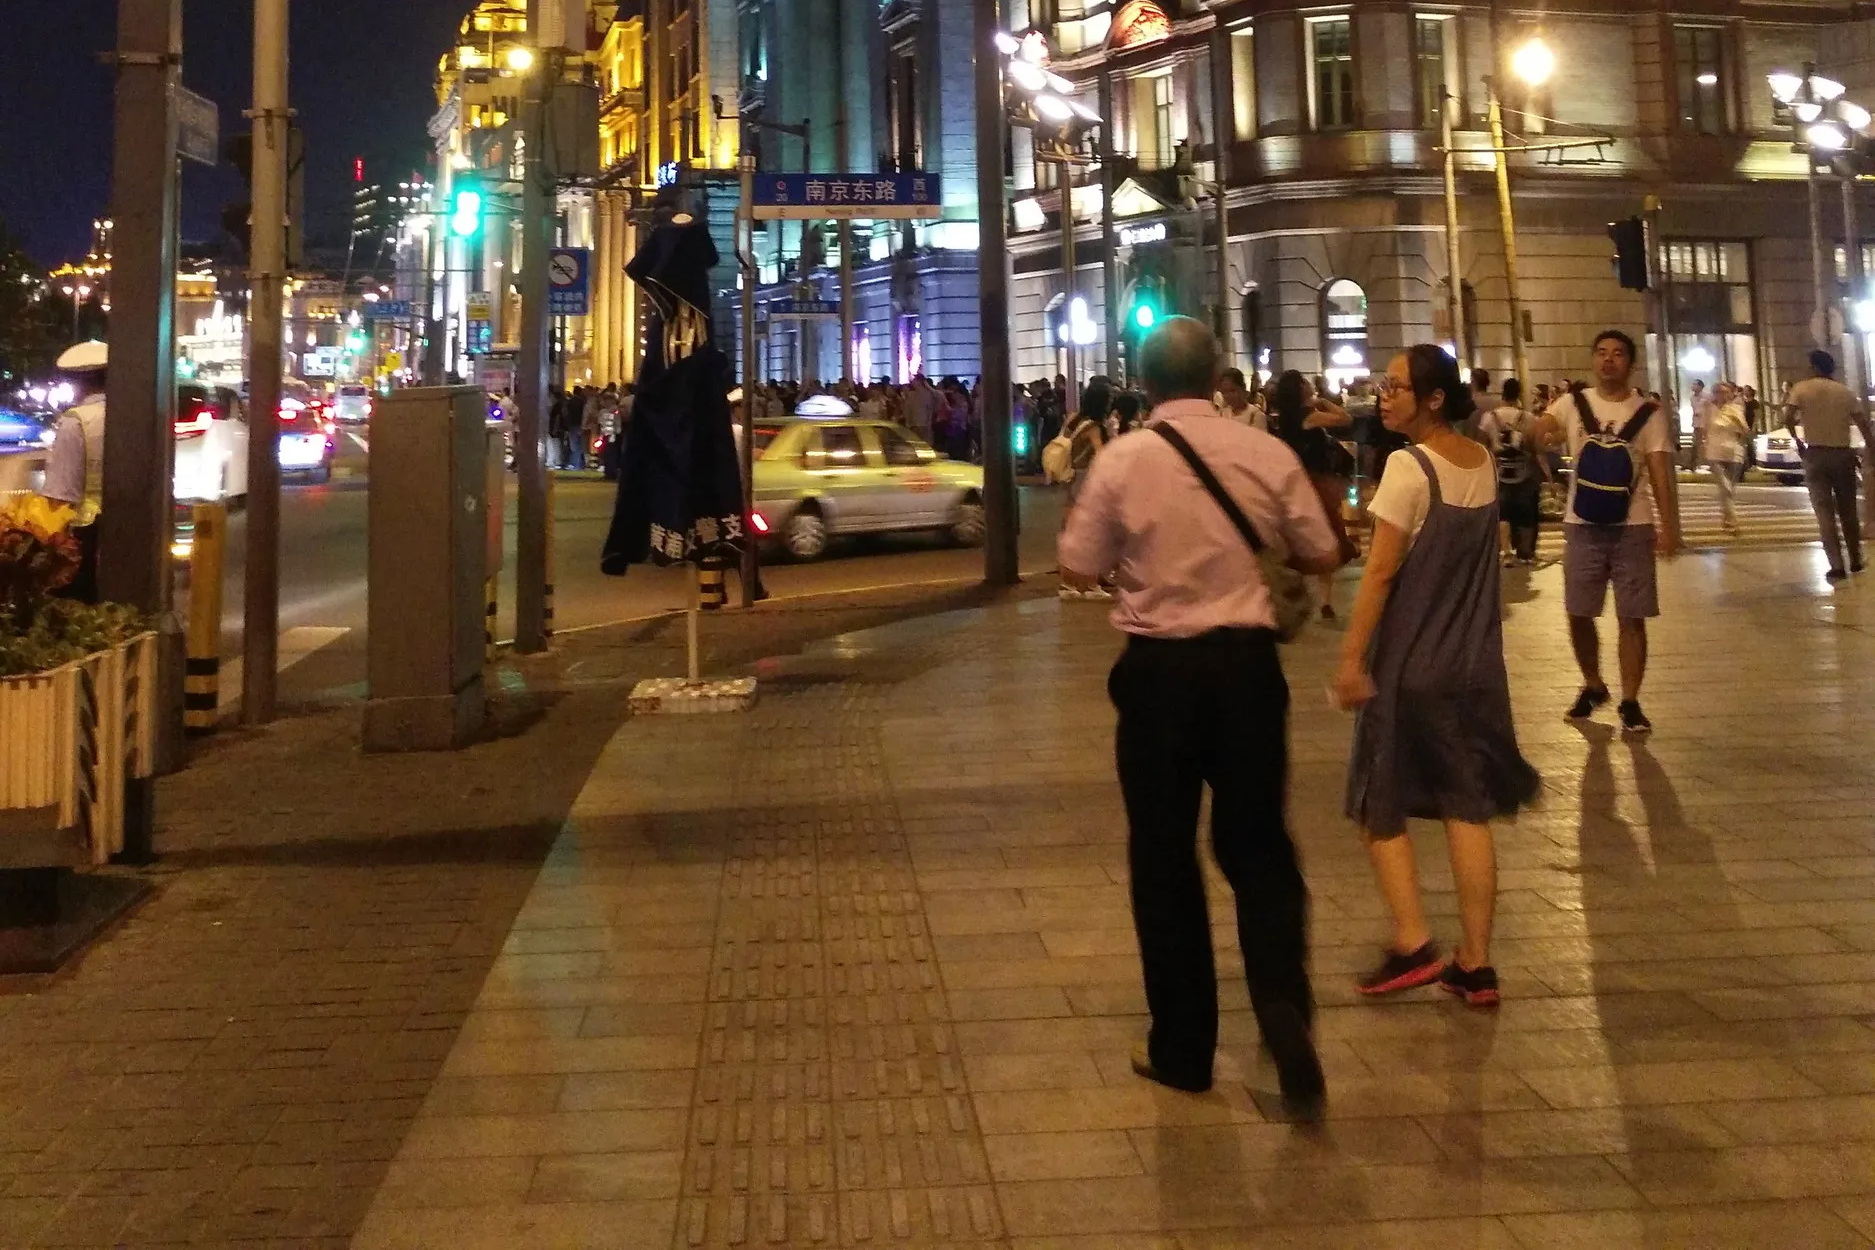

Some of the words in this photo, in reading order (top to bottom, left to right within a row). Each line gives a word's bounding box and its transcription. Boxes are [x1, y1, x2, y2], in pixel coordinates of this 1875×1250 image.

[805, 179, 896, 202] 南京东路
[912, 177, 927, 191] 西
